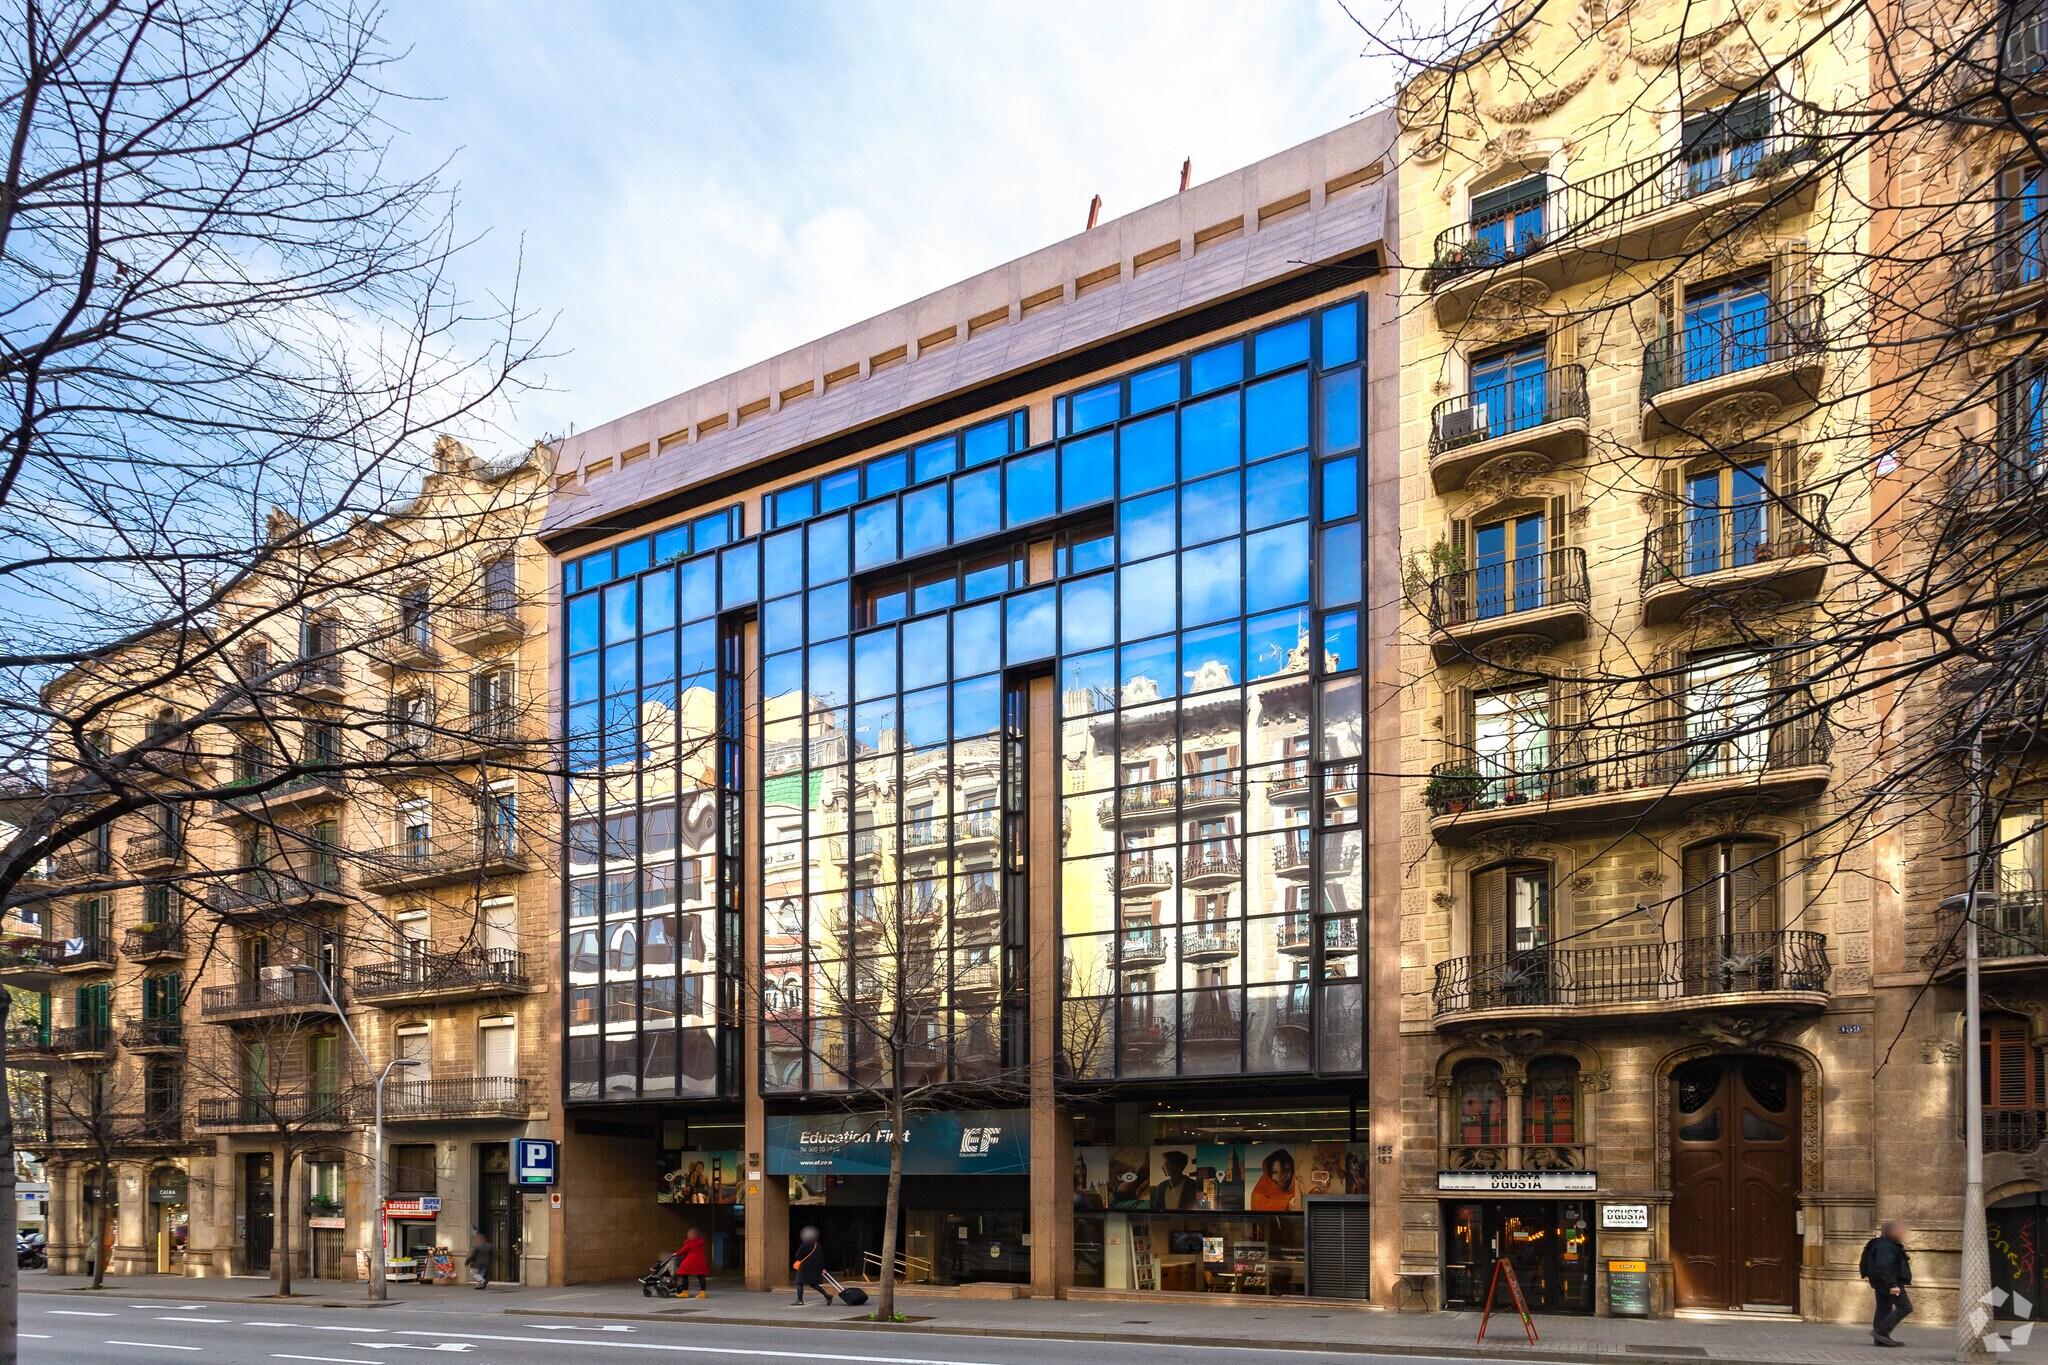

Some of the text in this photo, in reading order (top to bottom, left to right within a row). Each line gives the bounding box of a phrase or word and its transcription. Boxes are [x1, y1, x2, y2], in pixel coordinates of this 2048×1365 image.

[799, 1130, 871, 1144] Education
[958, 1127, 1001, 1152] EF
[527, 1144, 547, 1167] P
[1377, 1145, 1393, 1154] 155
[1377, 1155, 1393, 1164] 157
[1491, 1174, 1542, 1189] D'GUSTA
[1607, 1209, 1645, 1220] D'GUSTA
